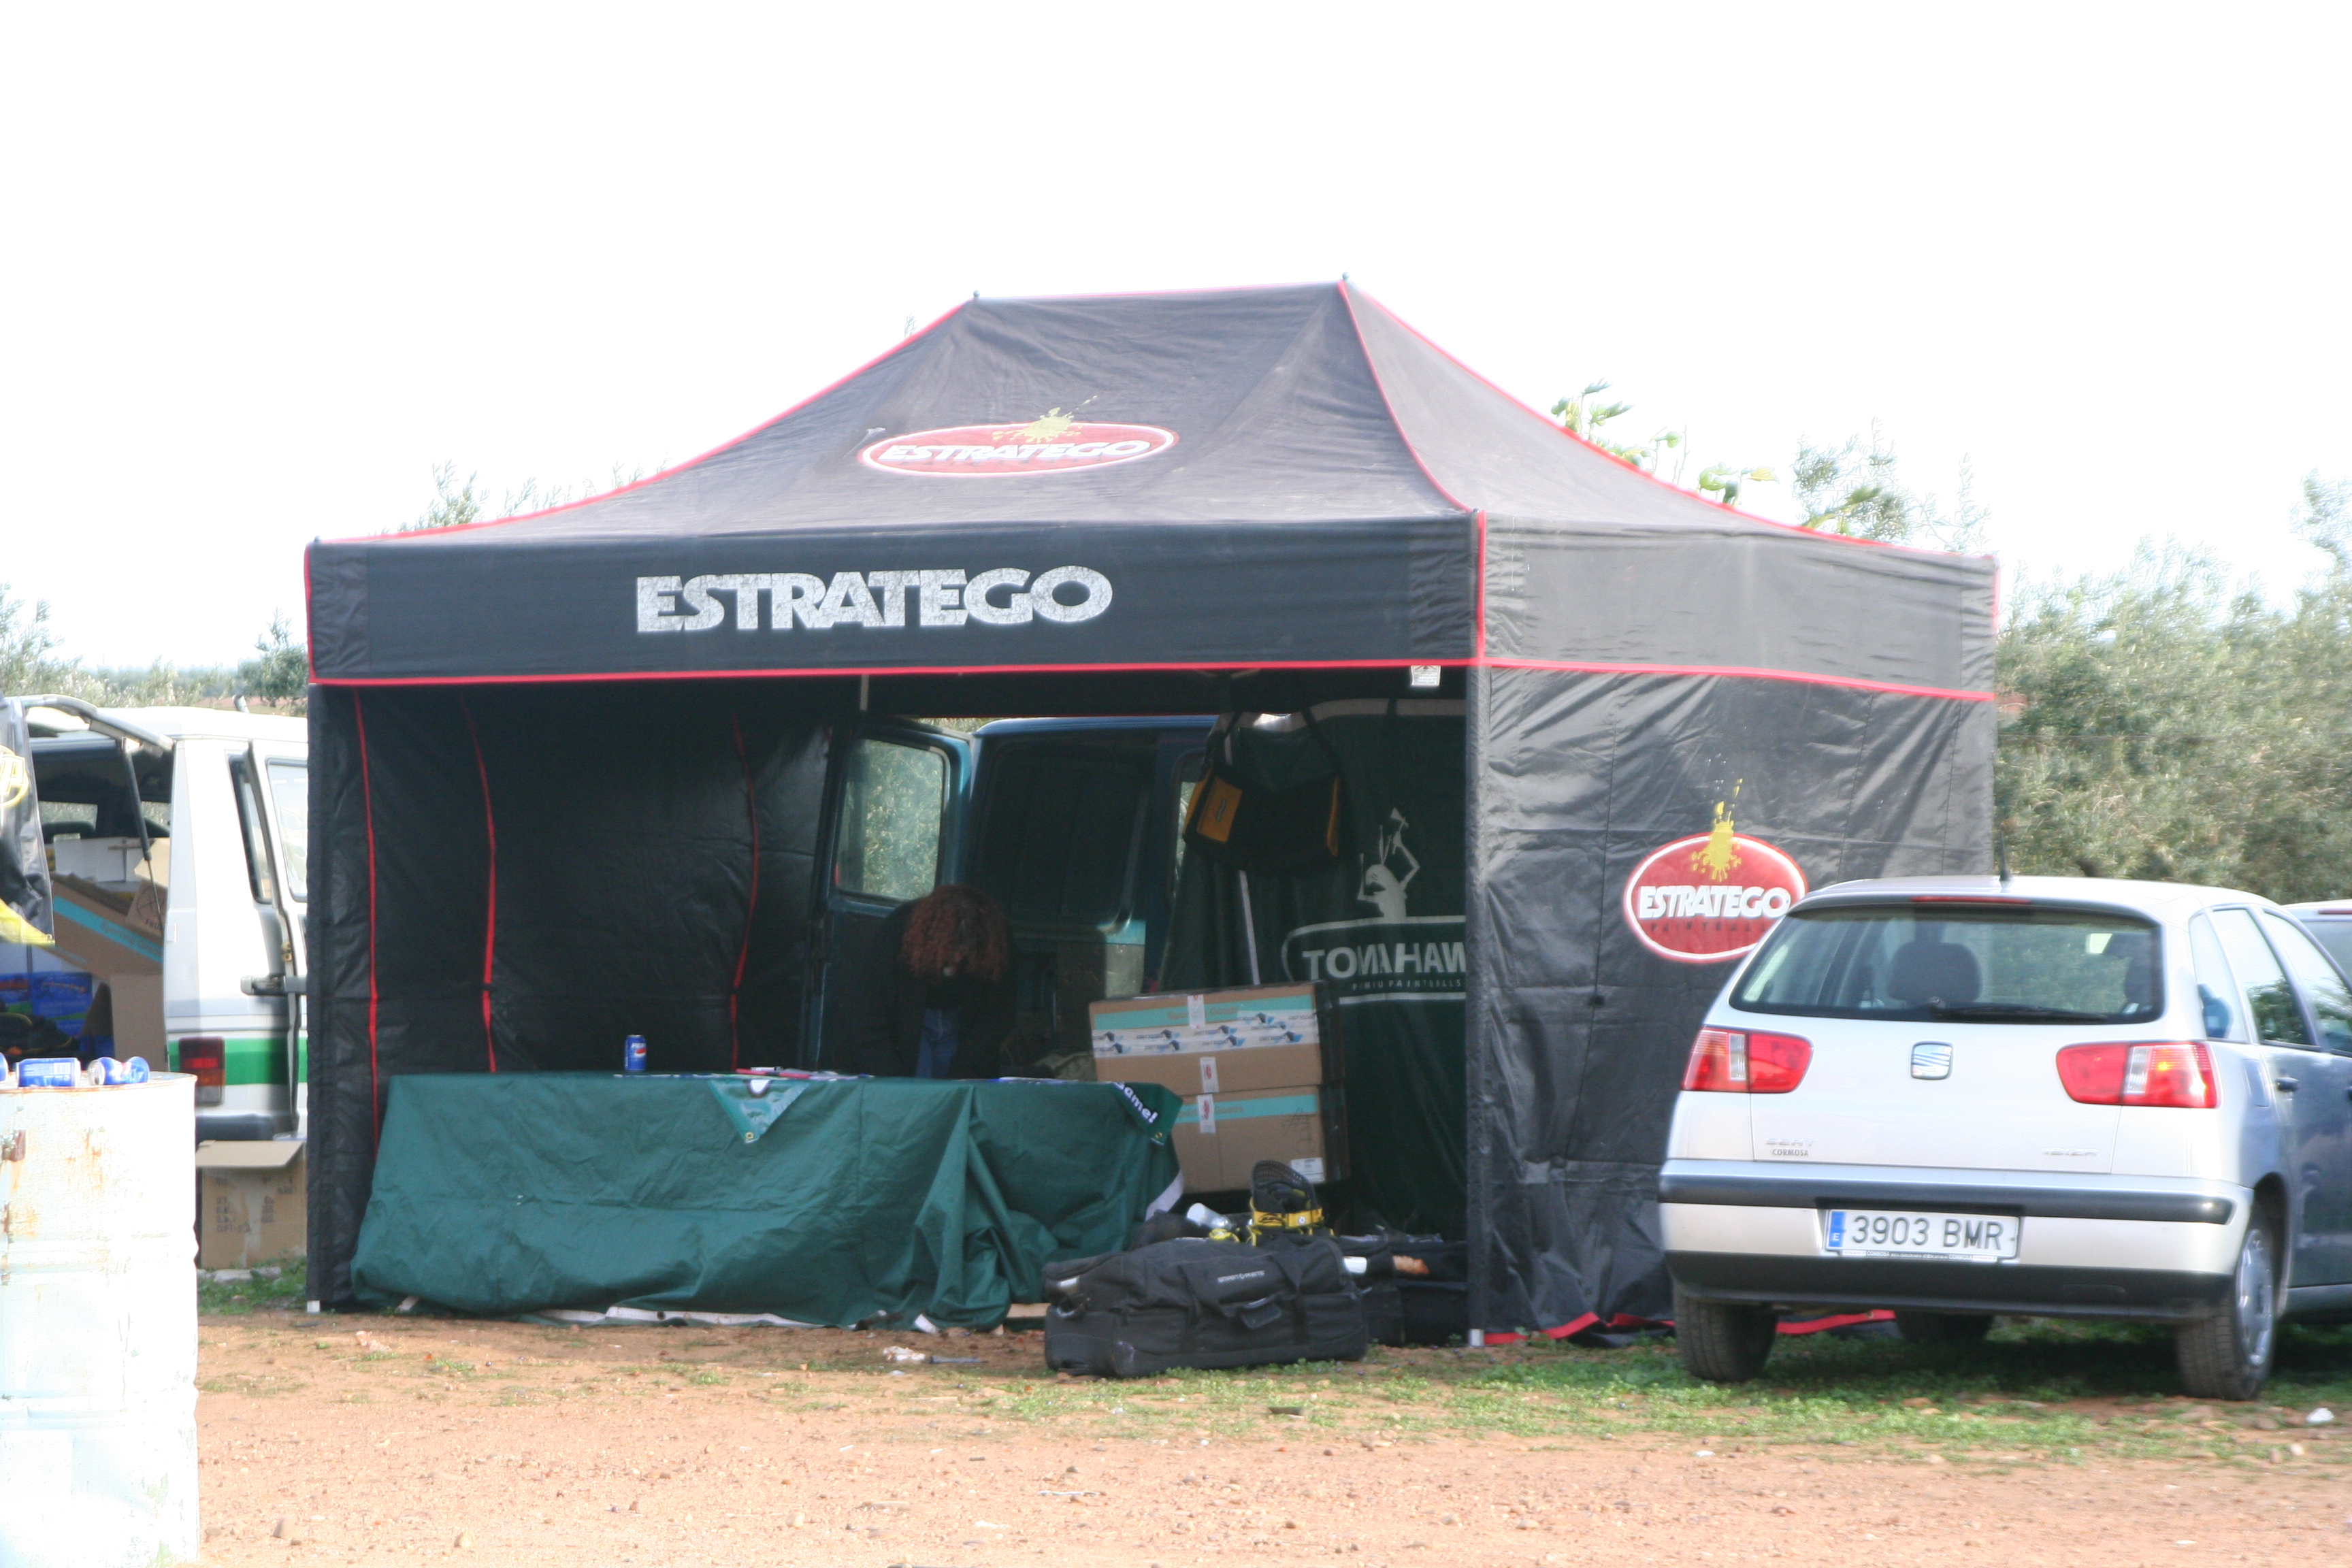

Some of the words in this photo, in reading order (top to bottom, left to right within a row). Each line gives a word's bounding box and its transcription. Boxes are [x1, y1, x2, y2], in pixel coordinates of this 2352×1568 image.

[877, 440, 1151, 462] ESTRATEGO
[637, 565, 1113, 632] ESTRATEGO
[1639, 885, 1791, 919] ESTRATEGO
[1772, 1148, 1810, 1156] CORMOSA
[1832, 1232, 1841, 1241] E
[1852, 1215, 1931, 1246] 3903
[1943, 1218, 2004, 1250] BMR
